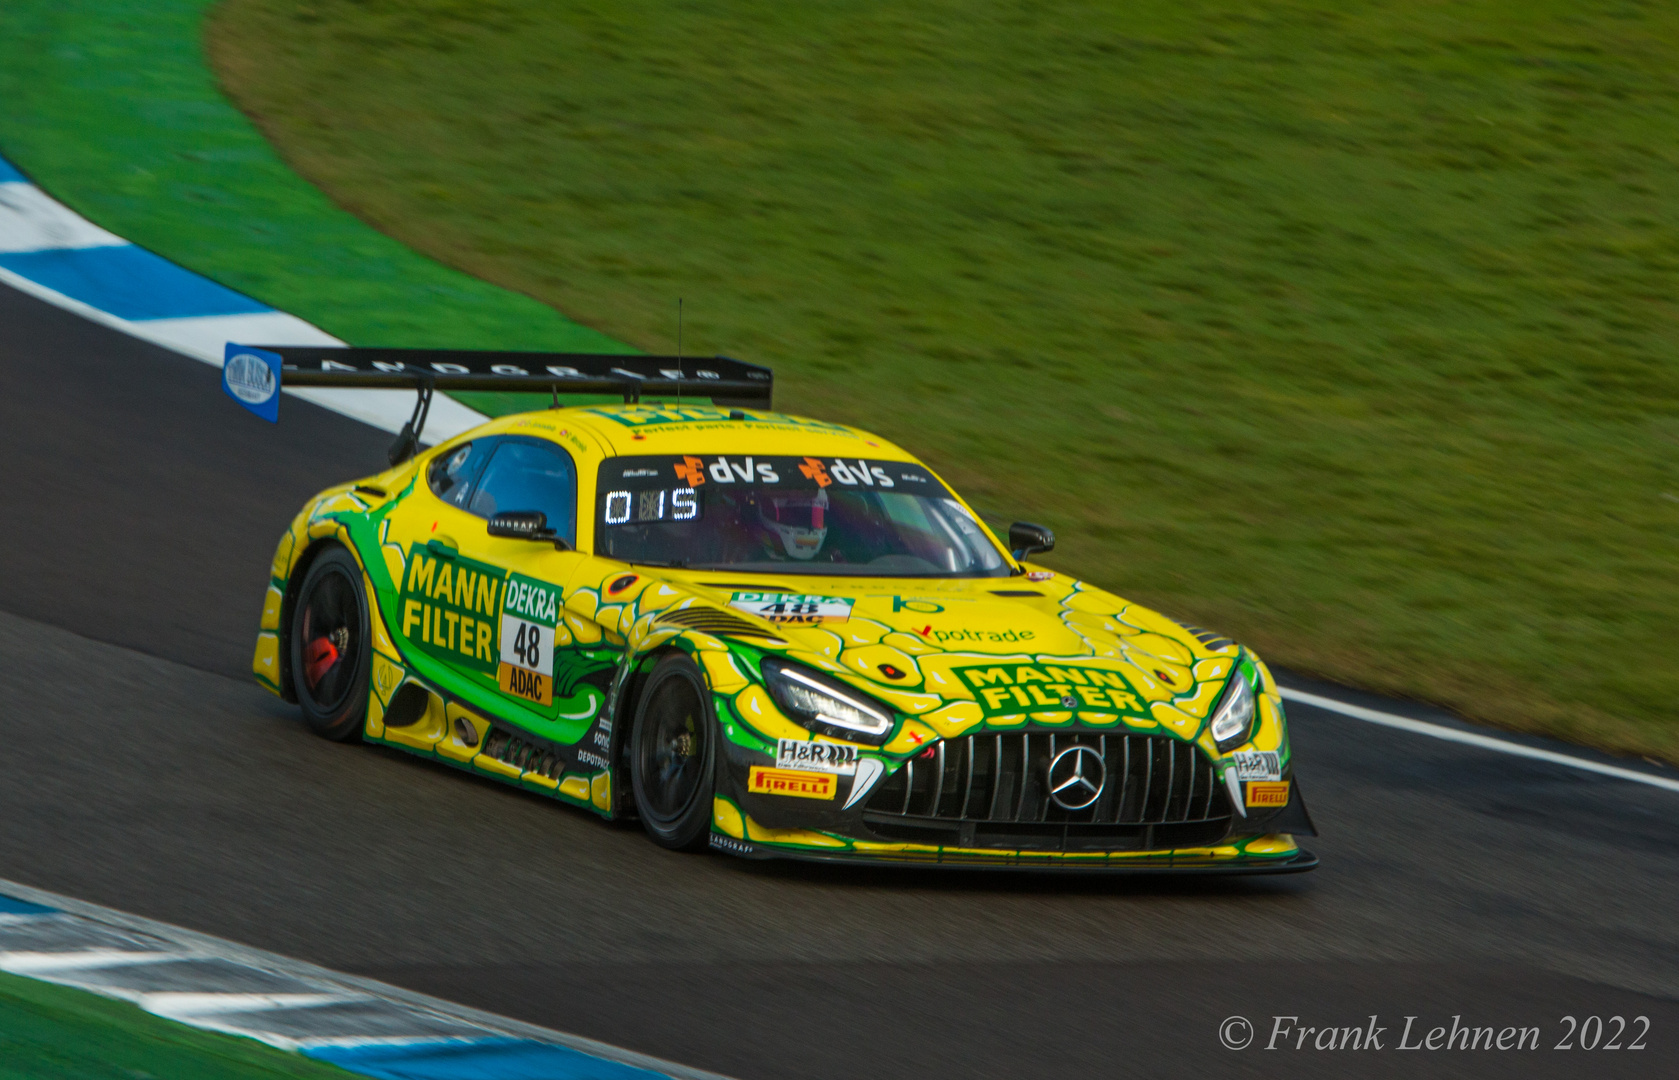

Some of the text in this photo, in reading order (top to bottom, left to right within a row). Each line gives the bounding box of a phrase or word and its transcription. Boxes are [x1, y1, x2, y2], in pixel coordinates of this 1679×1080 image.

[408, 553, 498, 617] MANN
[506, 579, 557, 623] DEKRA
[738, 592, 854, 606] DEKRA
[760, 603, 819, 614] 48
[402, 597, 493, 664] FILTER
[767, 615, 824, 624] DAC
[513, 622, 541, 669] 48
[934, 628, 1036, 644] potrade
[509, 667, 543, 702] ADAC
[964, 666, 1128, 690] MANN
[980, 684, 1145, 713] FILTER
[780, 740, 824, 763] H&R
[755, 771, 830, 794] PIRELLI
[1252, 786, 1288, 803] PIRELLI
